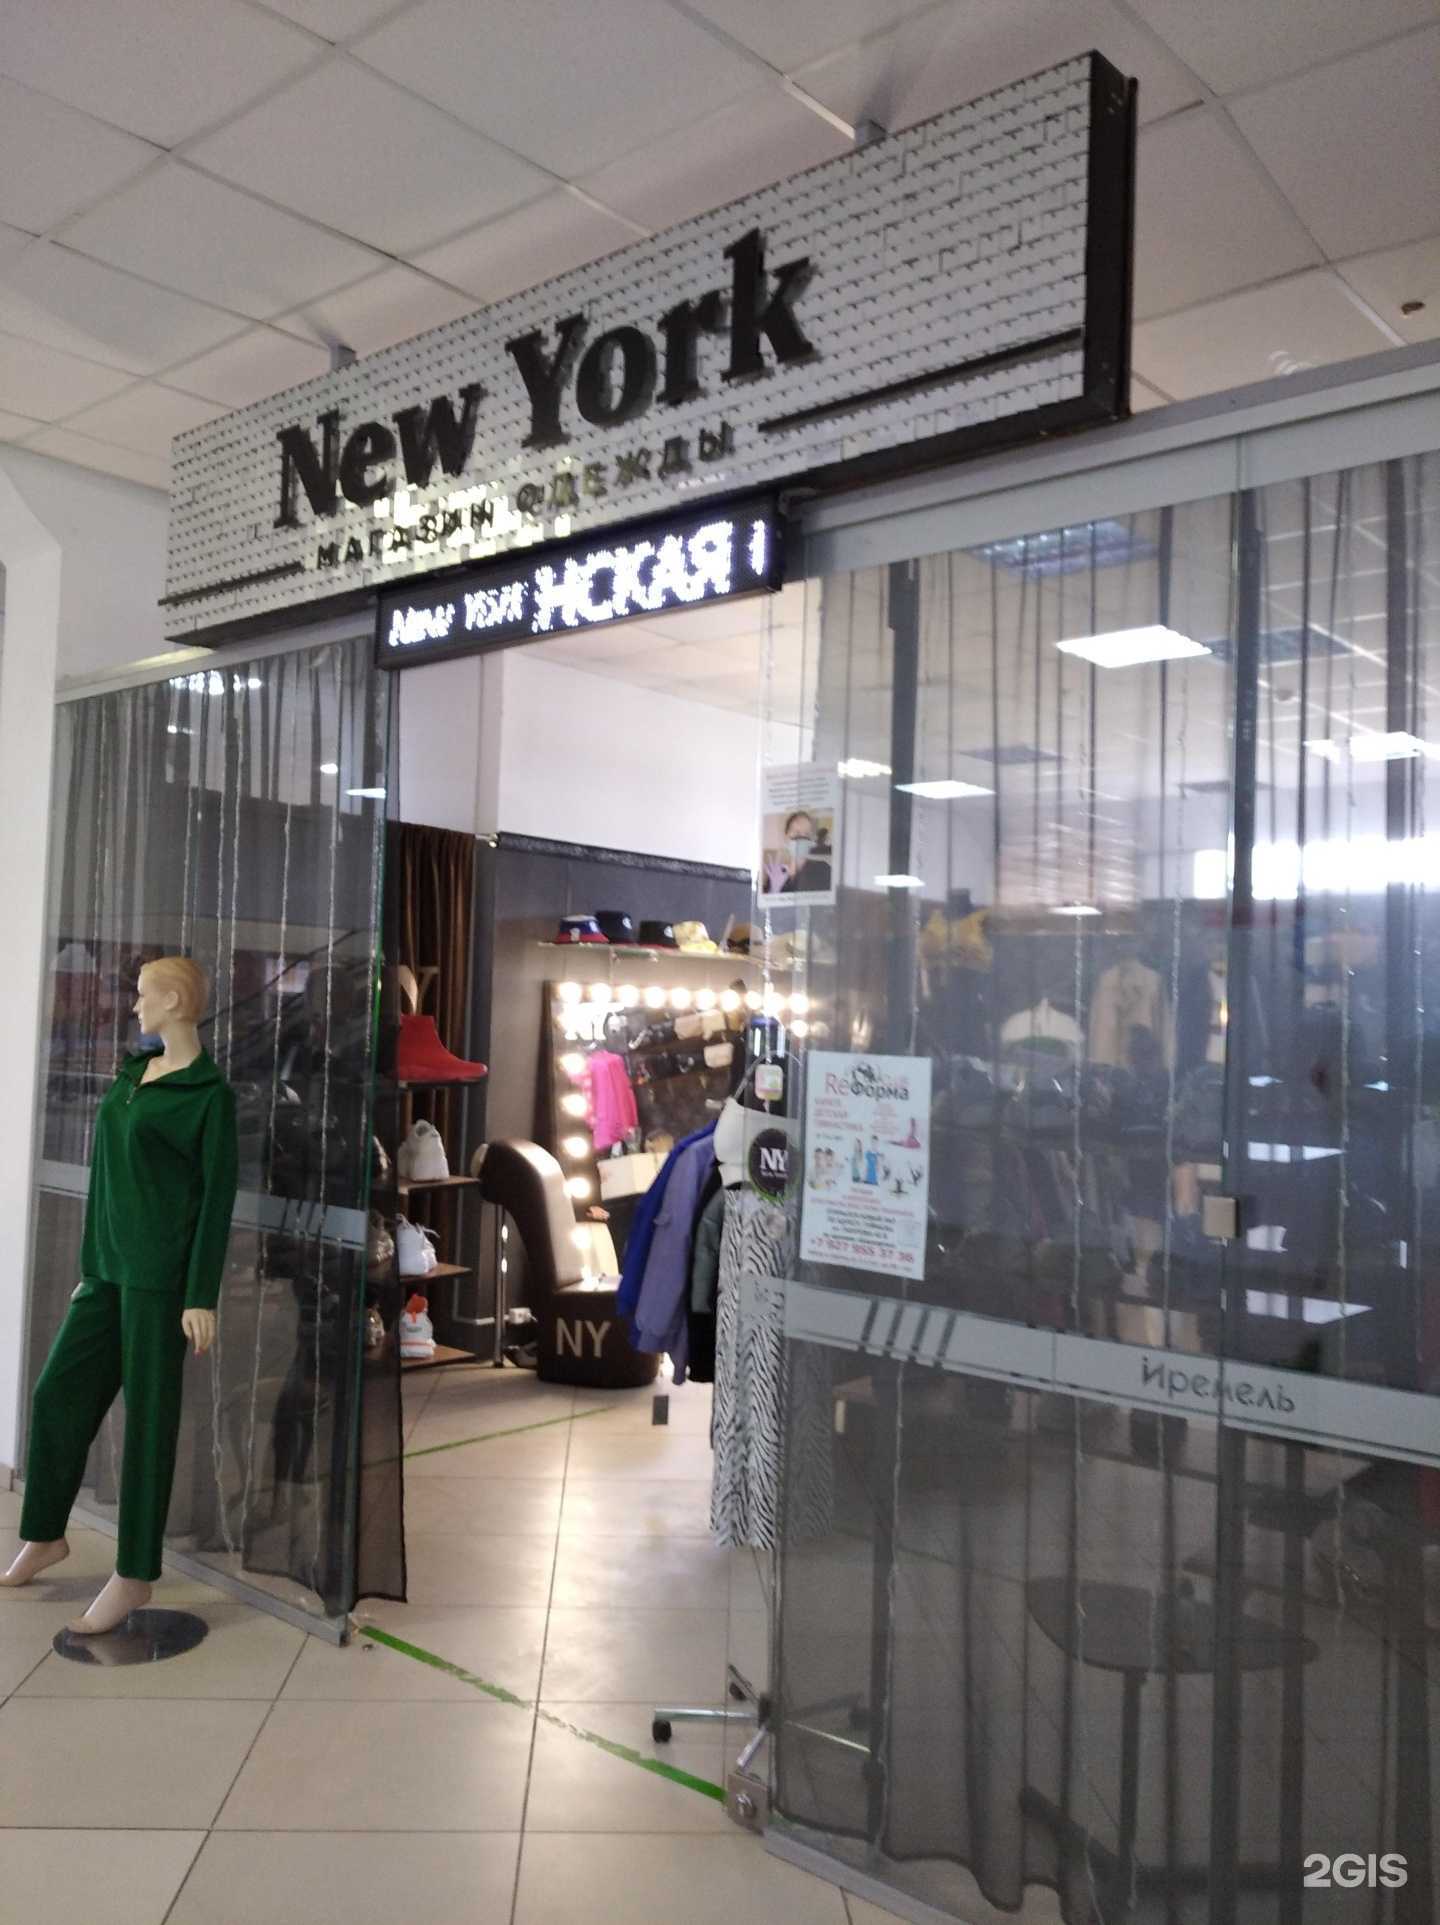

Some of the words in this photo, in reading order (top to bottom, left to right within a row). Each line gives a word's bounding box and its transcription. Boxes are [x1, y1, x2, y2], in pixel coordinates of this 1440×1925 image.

[273, 383, 487, 529] New
[505, 227, 818, 449] York
[316, 500, 495, 570] МАГАЗИН
[516, 422, 735, 514] ОДЕЖДЫ
[760, 1147, 789, 1171] NY
[556, 1317, 611, 1359] NY
